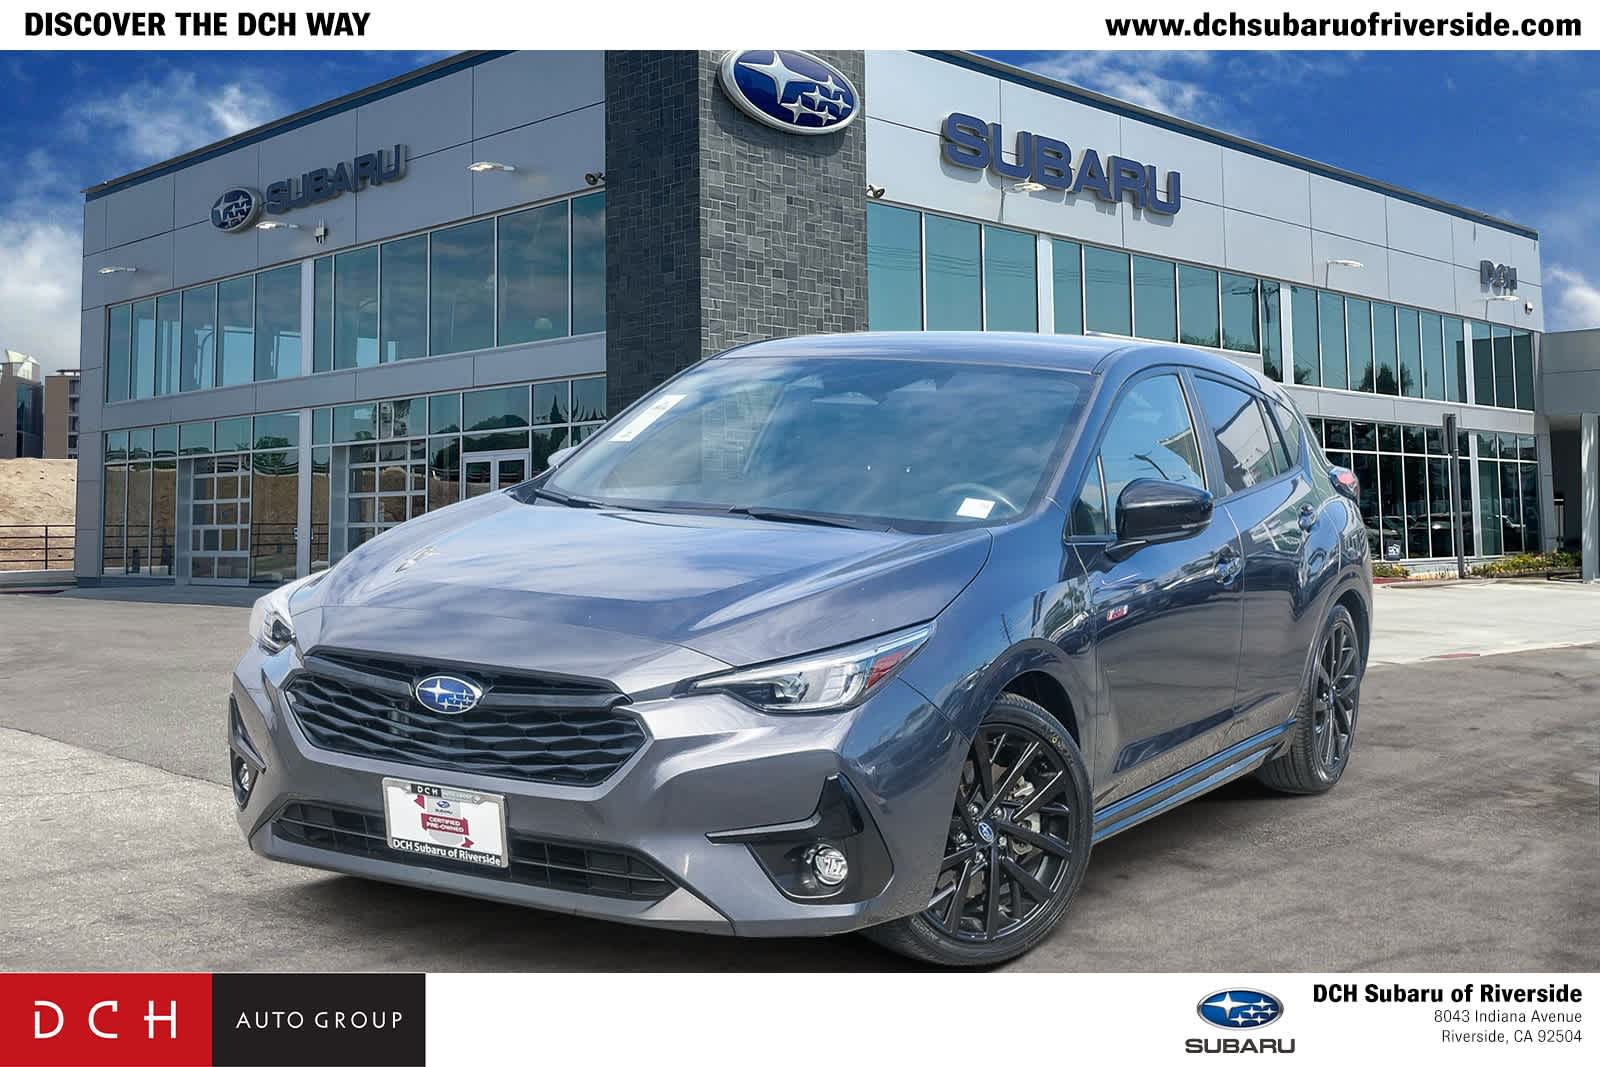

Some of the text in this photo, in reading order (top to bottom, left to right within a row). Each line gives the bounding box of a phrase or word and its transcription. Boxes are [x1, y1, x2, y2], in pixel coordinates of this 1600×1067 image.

[942, 112, 1181, 215] SUBARU
[266, 144, 407, 215] SUBARU
[417, 785, 438, 796] DCH
[426, 822, 464, 833] PRE-OWNED
[428, 817, 461, 827] CERTIFIED
[393, 839, 501, 866] DCH Subaru of Riverside
